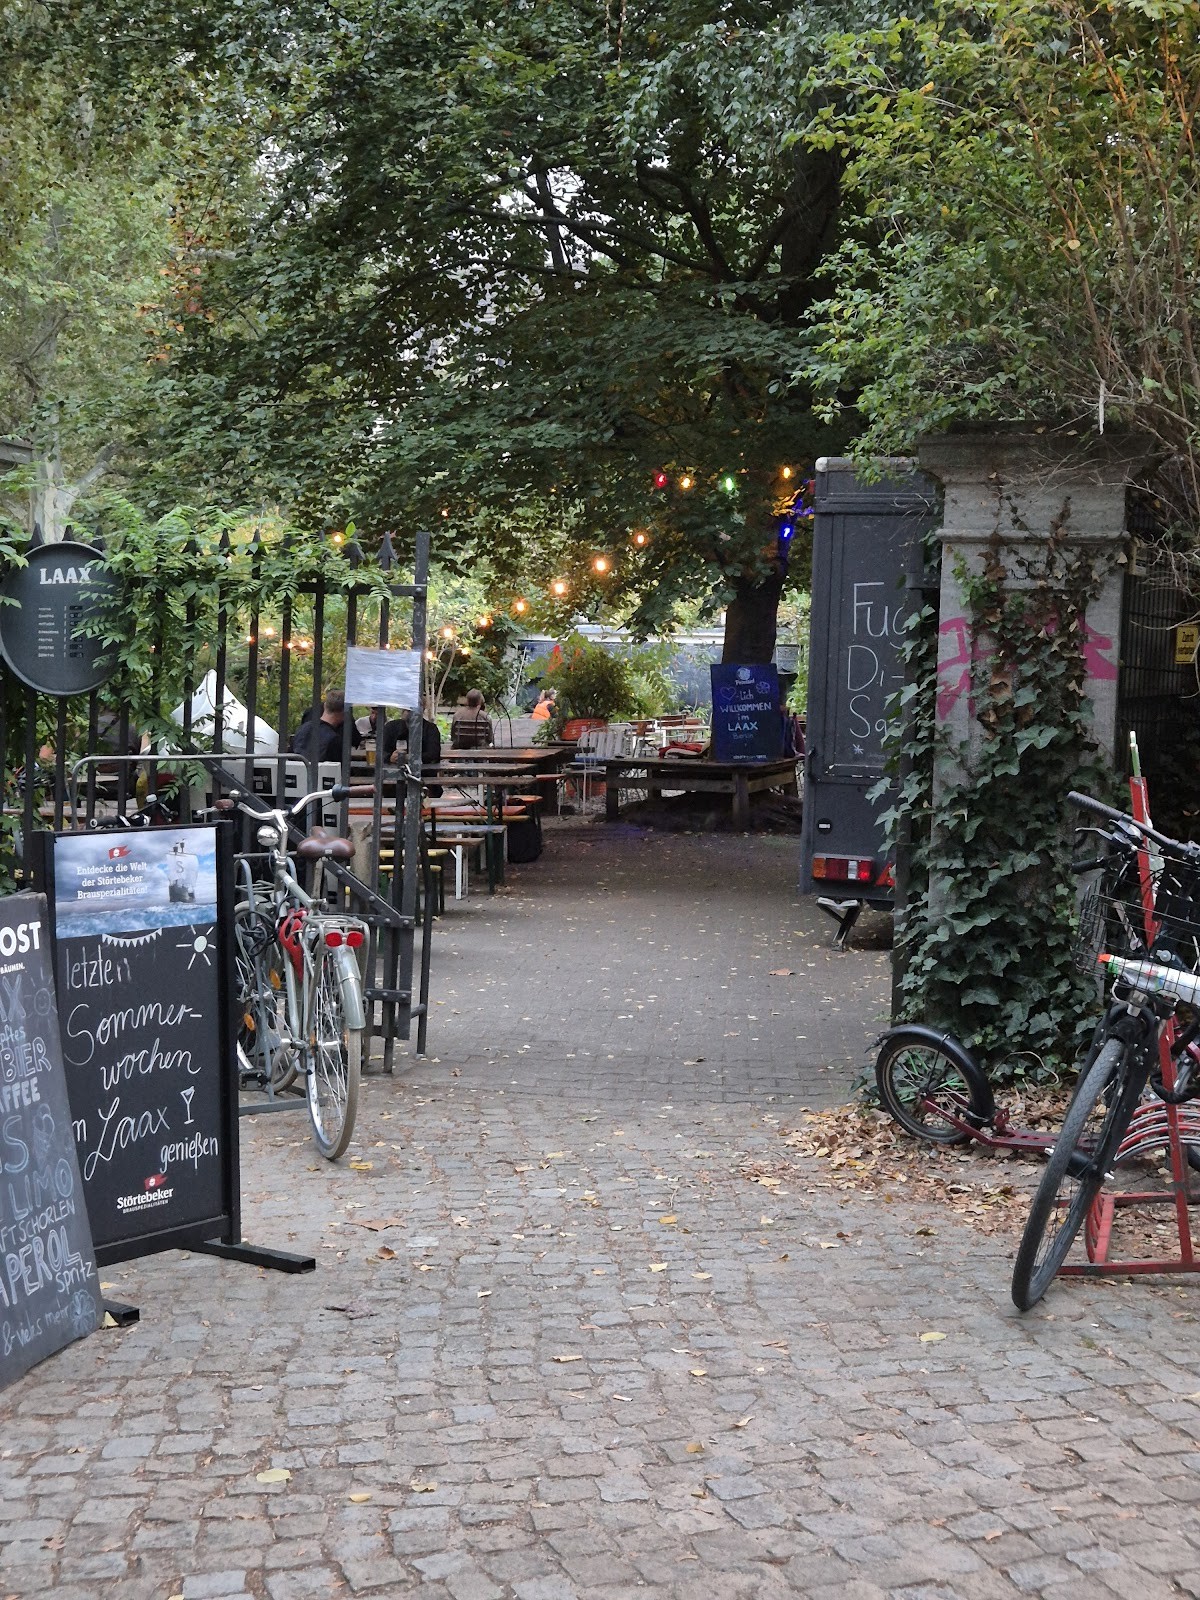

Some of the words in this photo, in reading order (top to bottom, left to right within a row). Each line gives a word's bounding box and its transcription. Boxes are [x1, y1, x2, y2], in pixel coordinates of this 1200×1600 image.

[39, 566, 92, 585] LAAX
[720, 702, 772, 713] WILLKOMMEN
[738, 713, 750, 721] im
[727, 721, 759, 732] LAAX
[76, 864, 114, 876] Entdecke
[115, 863, 128, 873] die
[129, 861, 148, 872] Welt
[77, 885, 148, 900] Brauspezialitäten!
[81, 877, 96, 888] der
[97, 875, 144, 887] Störtebeker
[65, 944, 133, 991] letzten
[64, 1003, 203, 1066] Sommer-
[0, 1036, 53, 1083] BIER
[100, 1037, 202, 1091] wochen
[83, 1096, 171, 1181] Laax
[159, 1131, 219, 1174] genießen
[8, 1157, 74, 1221] LIMO
[116, 1187, 174, 1210] Störtebeker
